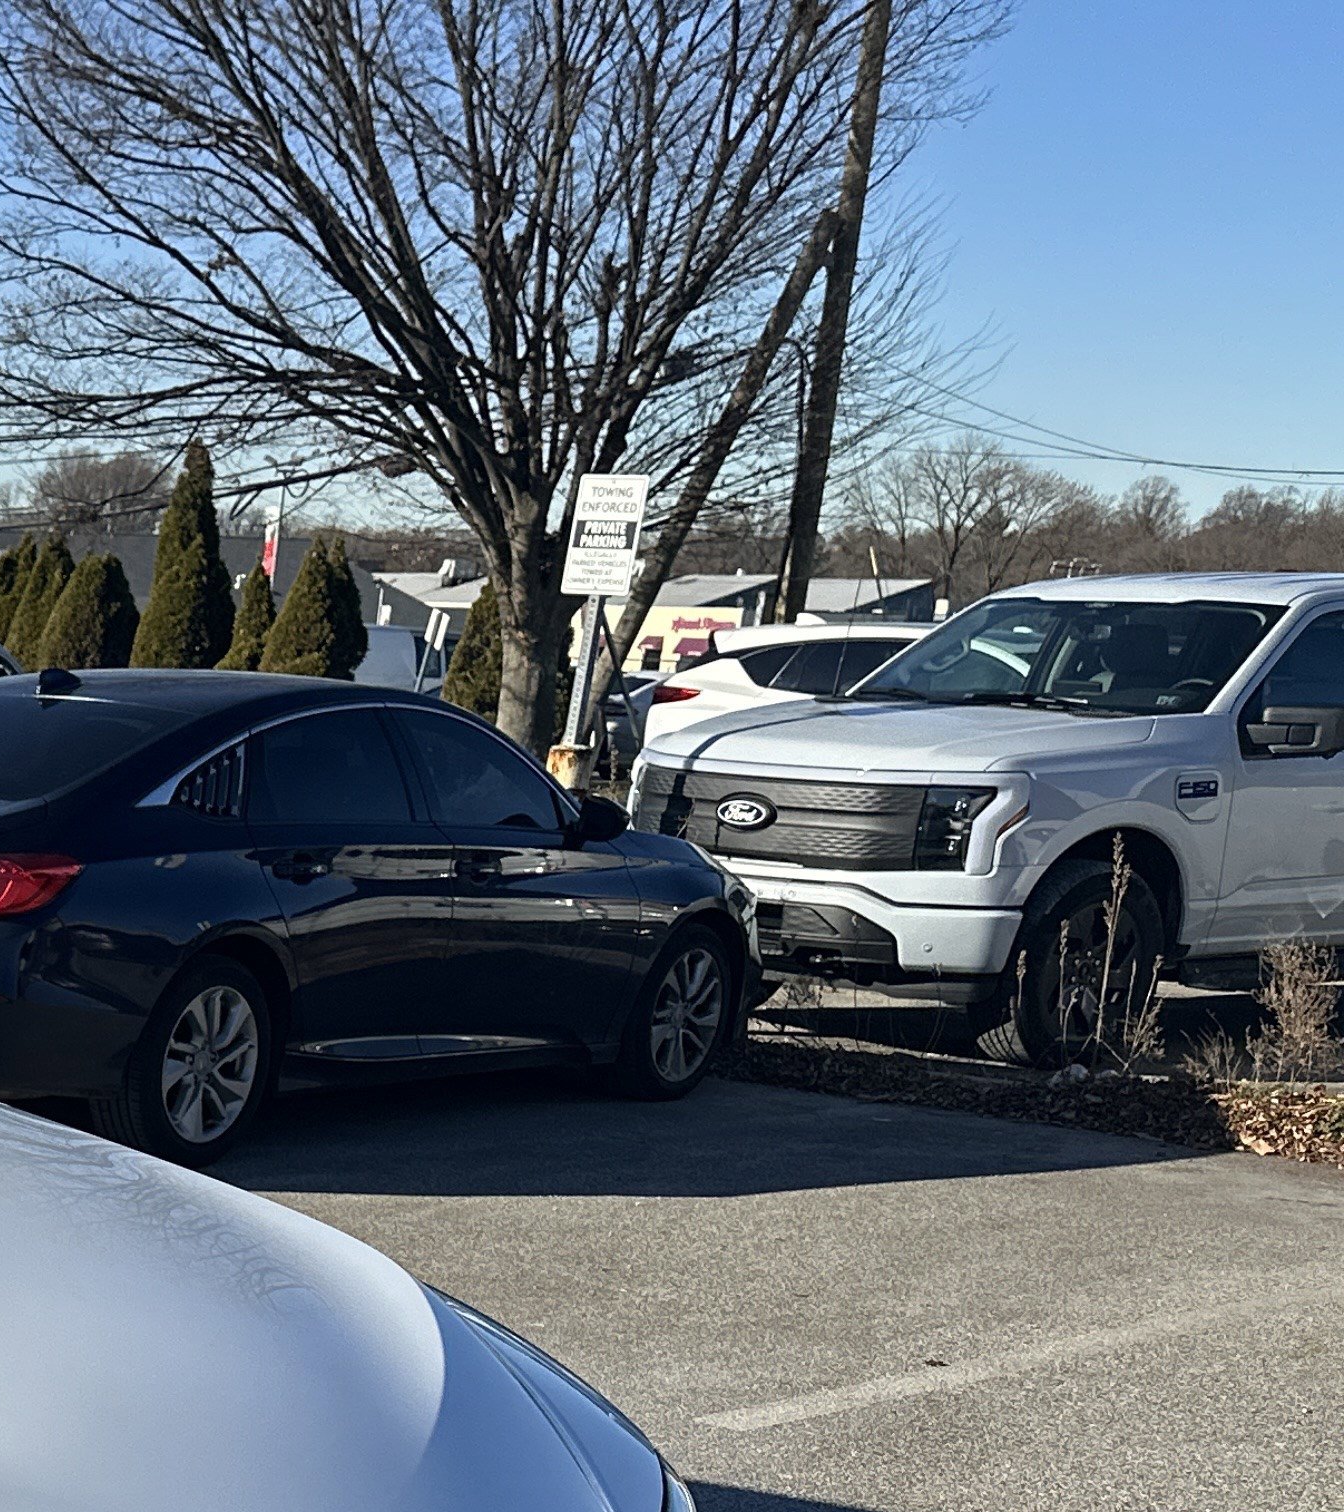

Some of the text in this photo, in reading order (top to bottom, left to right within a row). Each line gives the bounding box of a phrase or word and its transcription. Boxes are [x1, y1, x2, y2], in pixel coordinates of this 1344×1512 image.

[592, 487, 633, 497] TOWING
[582, 502, 637, 513] ENFORCED
[584, 521, 627, 535] PRIVATE
[580, 535, 627, 548] PARKING
[724, 802, 758, 821] Ford
